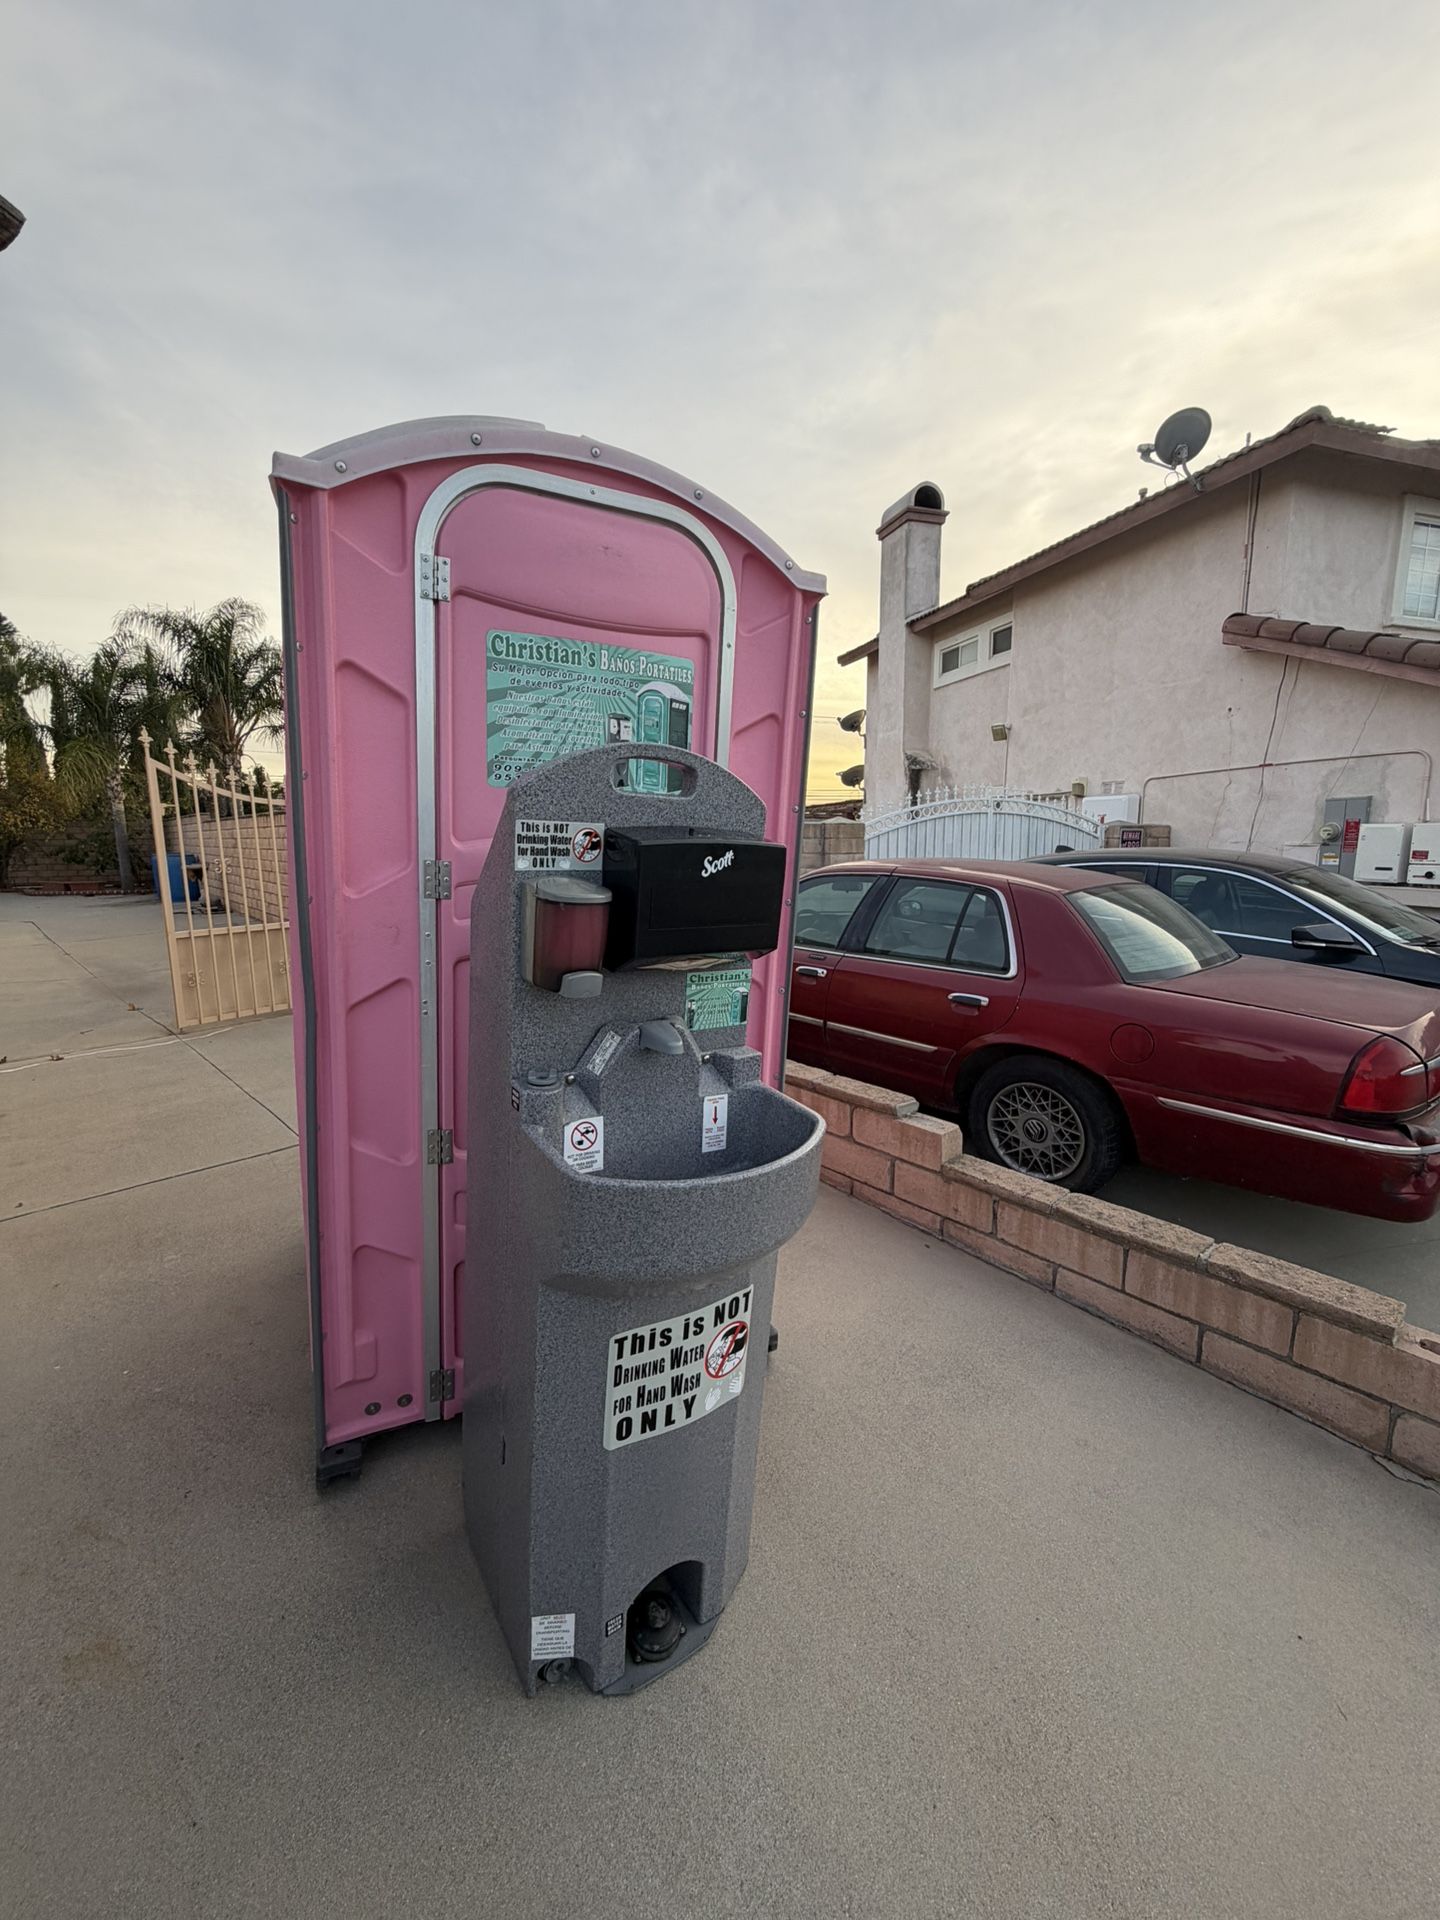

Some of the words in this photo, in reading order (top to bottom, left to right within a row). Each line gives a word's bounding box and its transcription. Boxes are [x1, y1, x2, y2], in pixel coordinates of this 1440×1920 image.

[491, 633, 596, 668] Christian's
[492, 662, 505, 672] Su
[508, 664, 536, 676] Mejor
[577, 673, 597, 683] para
[600, 675, 620, 686] todo
[622, 679, 640, 690] tipo
[506, 690, 545, 703] Nuestros
[510, 677, 522, 686] de
[525, 679, 563, 690] eventos
[566, 684, 574, 692] y
[575, 684, 627, 698] actividades
[493, 703, 539, 715] equipados
[520, 822, 540, 833] This
[542, 822, 551, 833] is
[553, 823, 570, 834] NOT
[517, 834, 549, 846] Drinking
[550, 835, 573, 846] Water
[517, 846, 529, 857] for
[530, 846, 549, 857] Hand
[550, 846, 571, 857] Wash
[532, 857, 556, 868] ONLY
[701, 849, 734, 878] Scott
[689, 971, 749, 984] Christian's
[613, 1328, 673, 1361] This
[682, 1316, 705, 1341] is
[713, 1290, 752, 1328] NOT
[613, 1357, 666, 1388] DRINKING
[670, 1344, 705, 1371] WATER
[636, 1385, 666, 1408] HAND
[671, 1372, 702, 1398] WASH
[615, 1394, 698, 1441] ONLY
